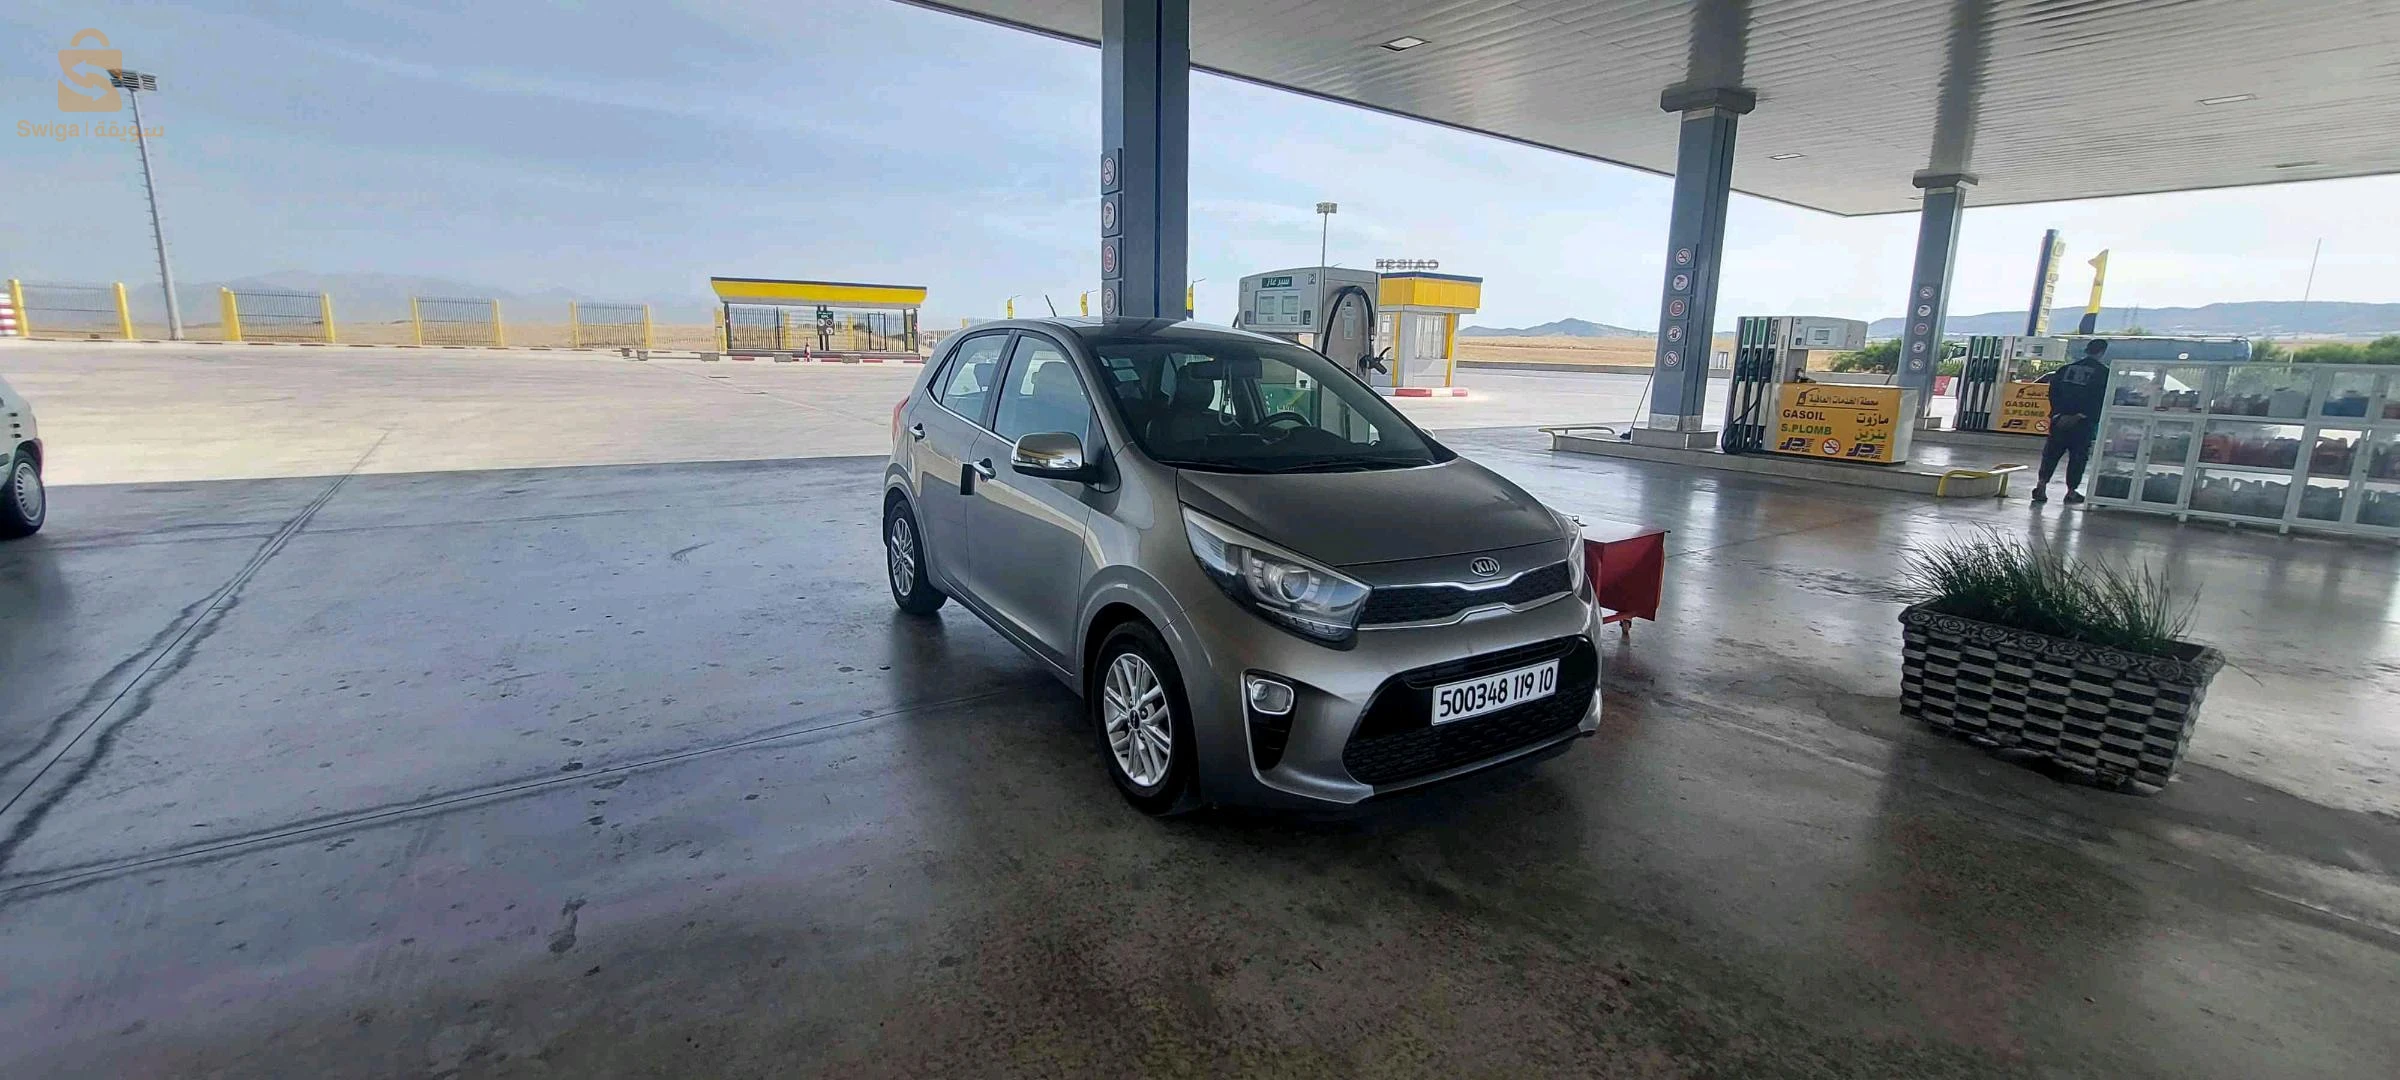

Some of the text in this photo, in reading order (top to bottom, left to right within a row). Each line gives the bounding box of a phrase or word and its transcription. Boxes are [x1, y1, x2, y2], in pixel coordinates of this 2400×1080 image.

[2005, 400, 2040, 409] GASOIL
[1783, 409, 1826, 421] GASOIL
[1856, 412, 1889, 427] مازوت
[1780, 423, 1832, 436] S.PLOMB
[1475, 560, 1498, 573] KIA
[1440, 666, 1554, 718] 500348 119 10
